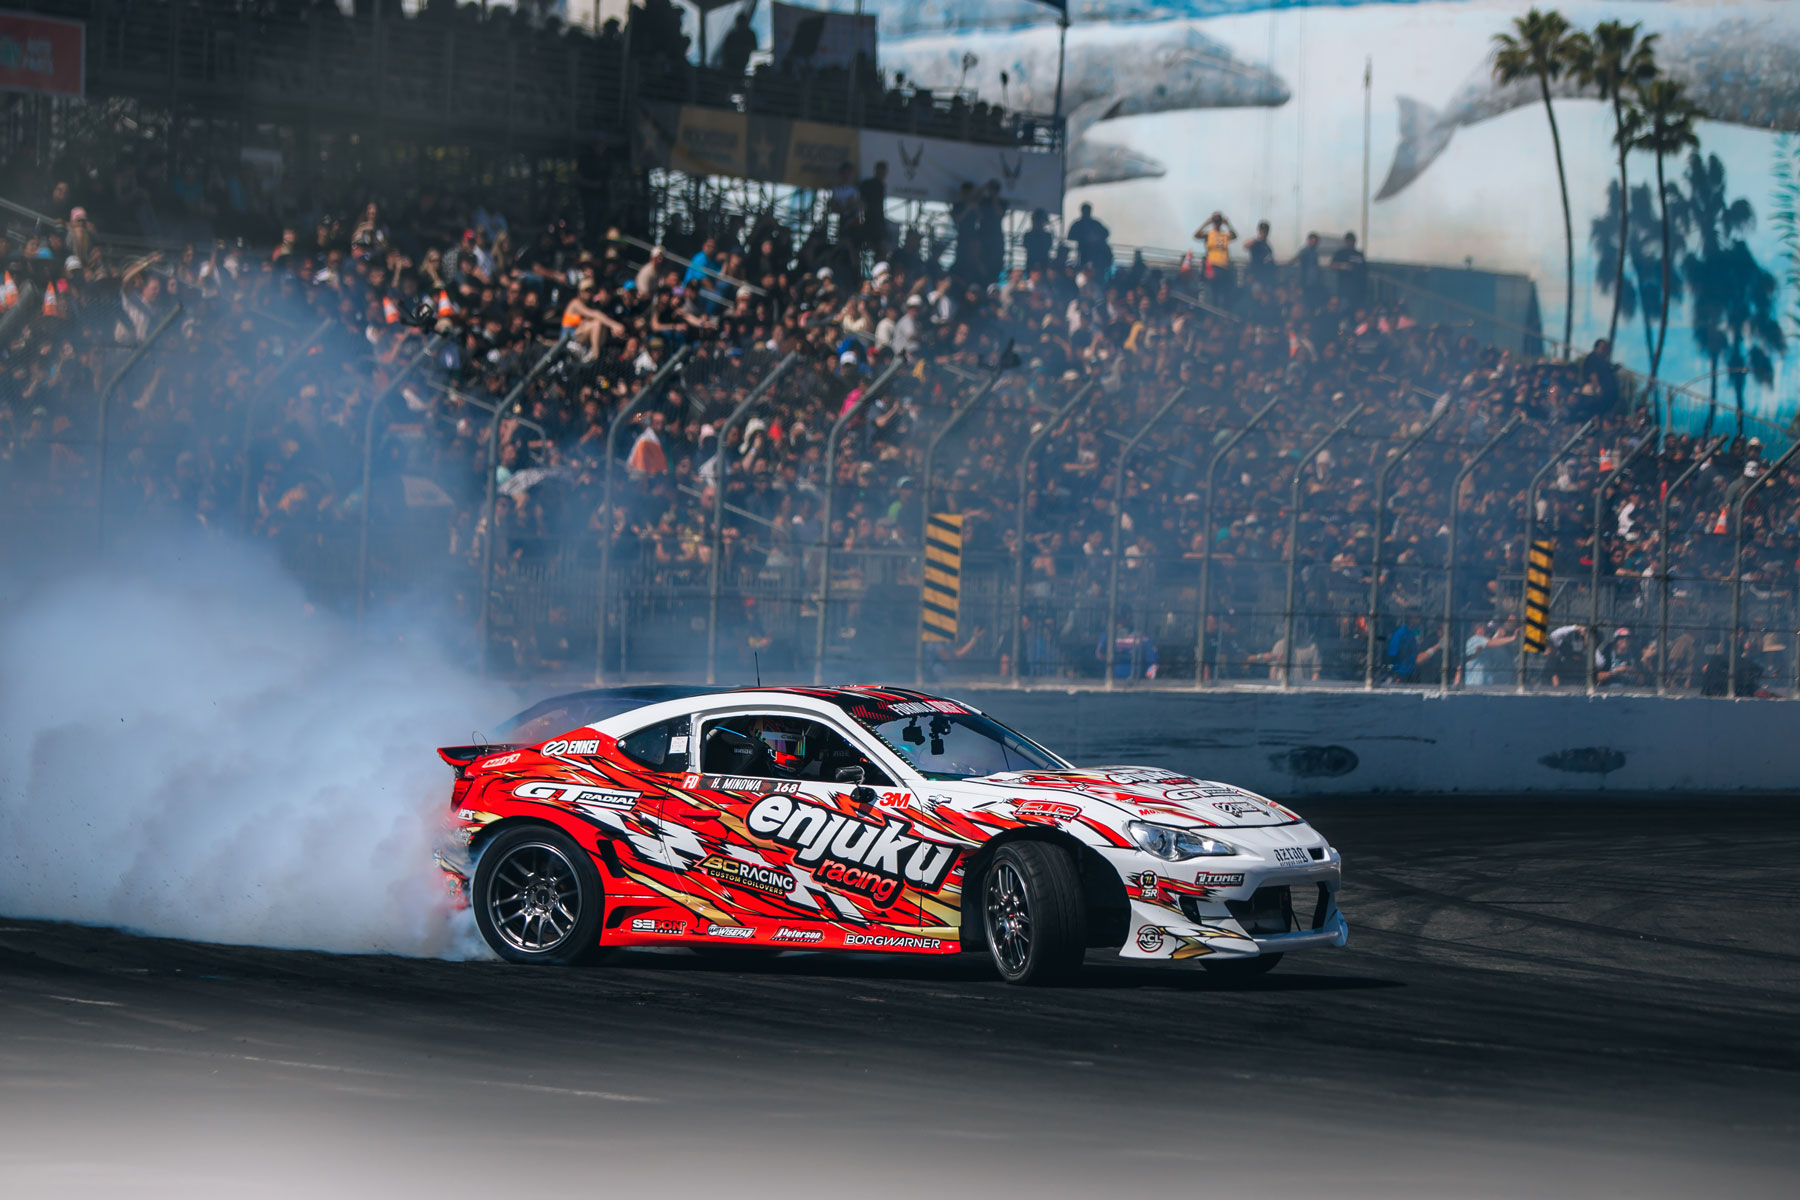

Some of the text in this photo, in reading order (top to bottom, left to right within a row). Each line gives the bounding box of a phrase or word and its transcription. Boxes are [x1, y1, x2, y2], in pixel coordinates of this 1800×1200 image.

[566, 740, 600, 755] ENKEI
[683, 775, 700, 789] FD
[711, 777, 762, 791] H. MINOWA
[774, 782, 798, 793] 168
[513, 781, 636, 805] GT RADIAL
[880, 792, 911, 807] 3M
[749, 795, 954, 884] enjuku
[1274, 847, 1308, 863] azrag
[710, 869, 784, 896] CUSTOM COILOVERS
[740, 864, 793, 890] RACING
[817, 859, 898, 902] racing
[1207, 874, 1243, 882] TOMEI
[632, 919, 683, 930] SEIBON
[718, 926, 754, 938] WISEFAB
[777, 928, 822, 939] Peterson
[1138, 933, 1161, 943] ACL
[845, 935, 942, 949] BORGWARNER
